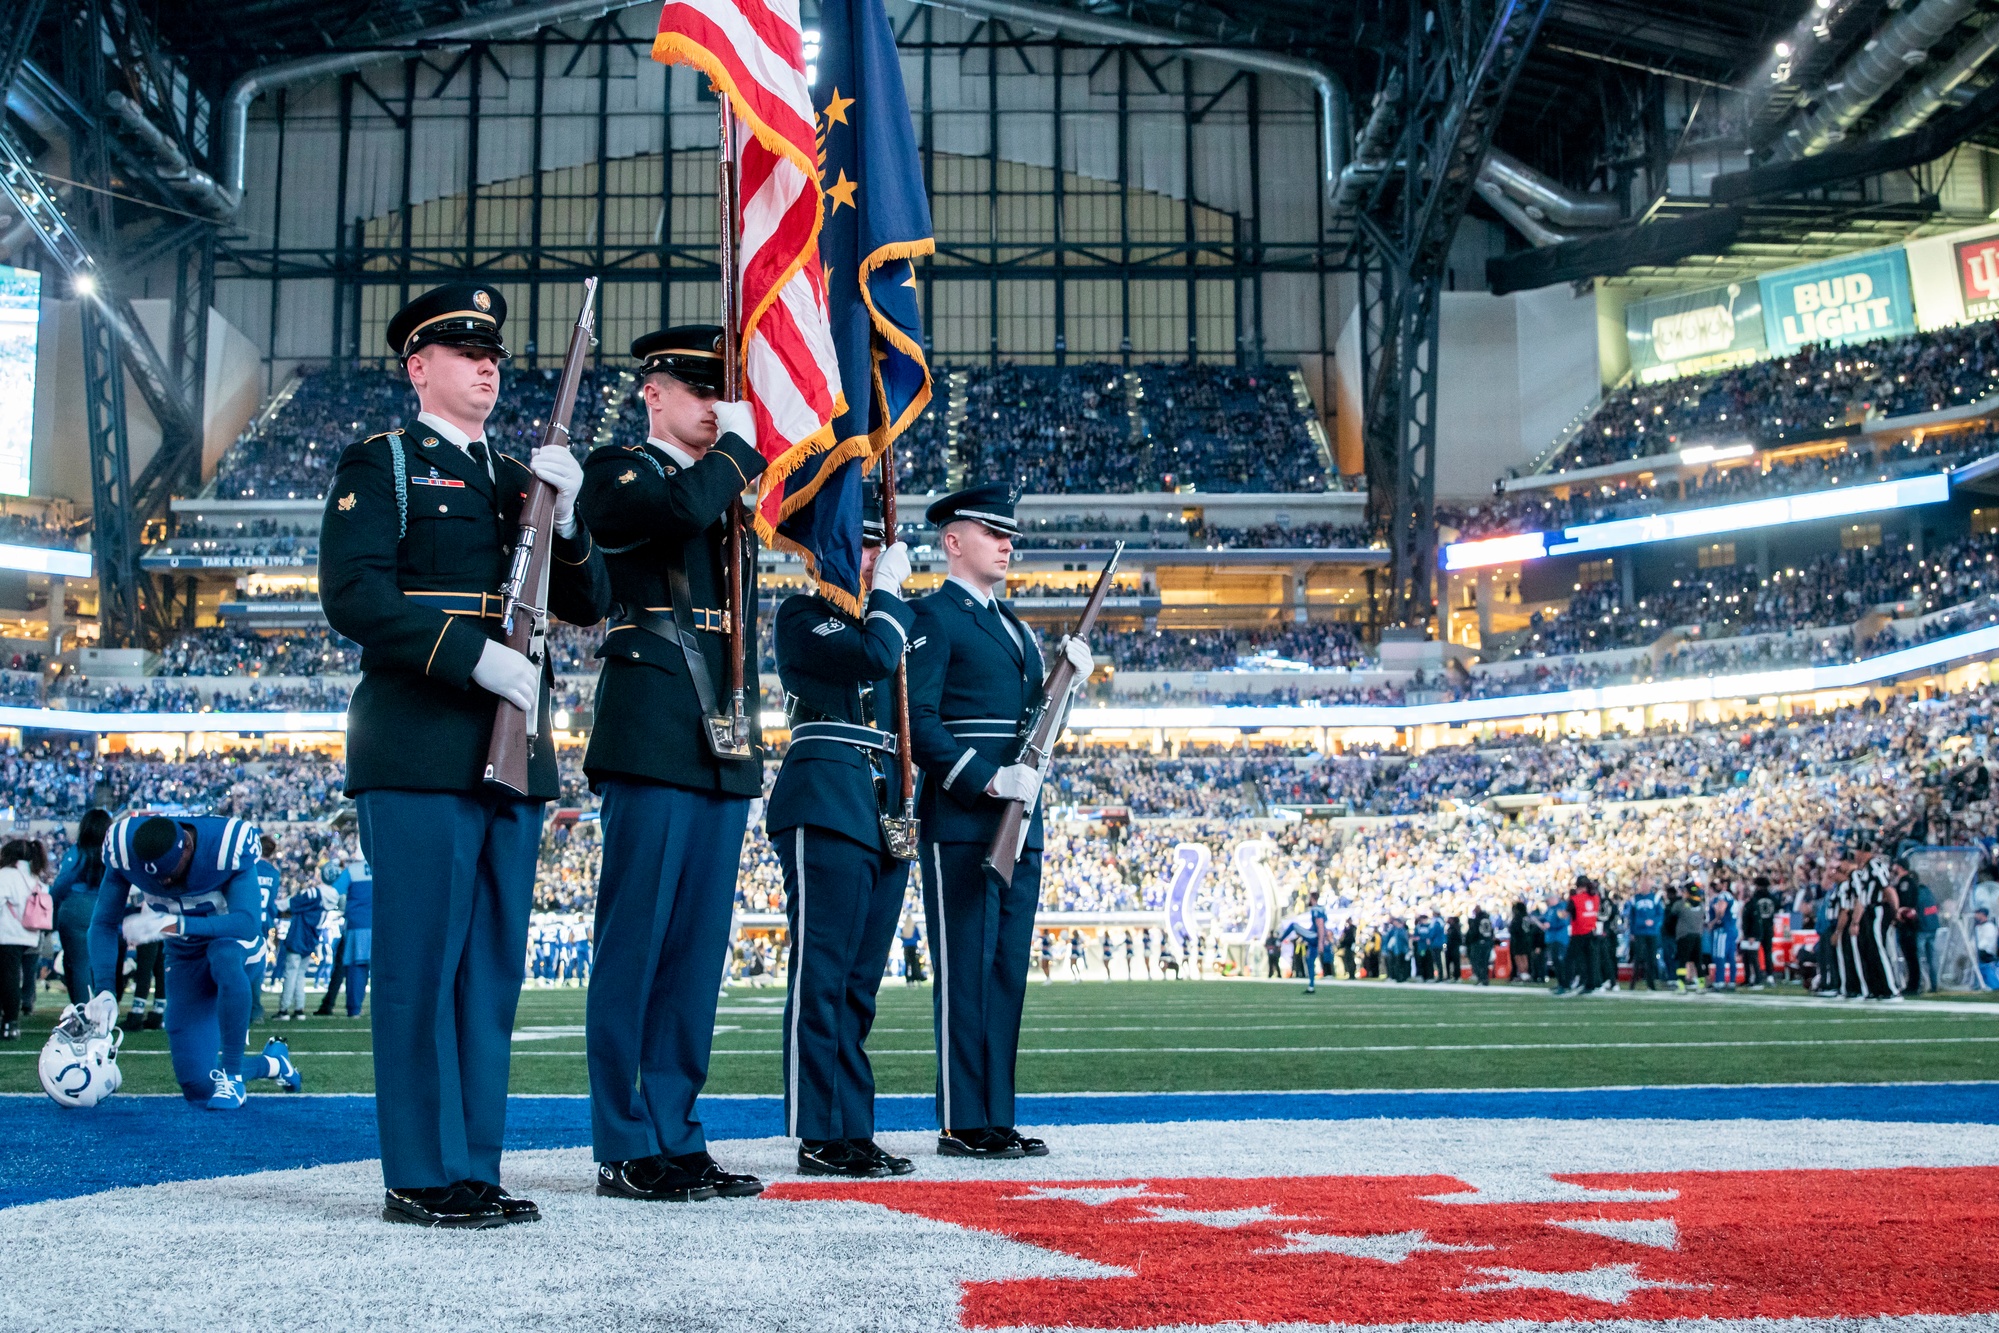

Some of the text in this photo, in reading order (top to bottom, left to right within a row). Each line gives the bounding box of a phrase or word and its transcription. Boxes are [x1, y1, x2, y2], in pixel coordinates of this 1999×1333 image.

[1793, 272, 1873, 314] BUD
[1782, 296, 1891, 345] LIGHT
[1967, 301, 1999, 317] HEA
[201, 556, 231, 568] TARIK
[232, 556, 266, 568] GLENN
